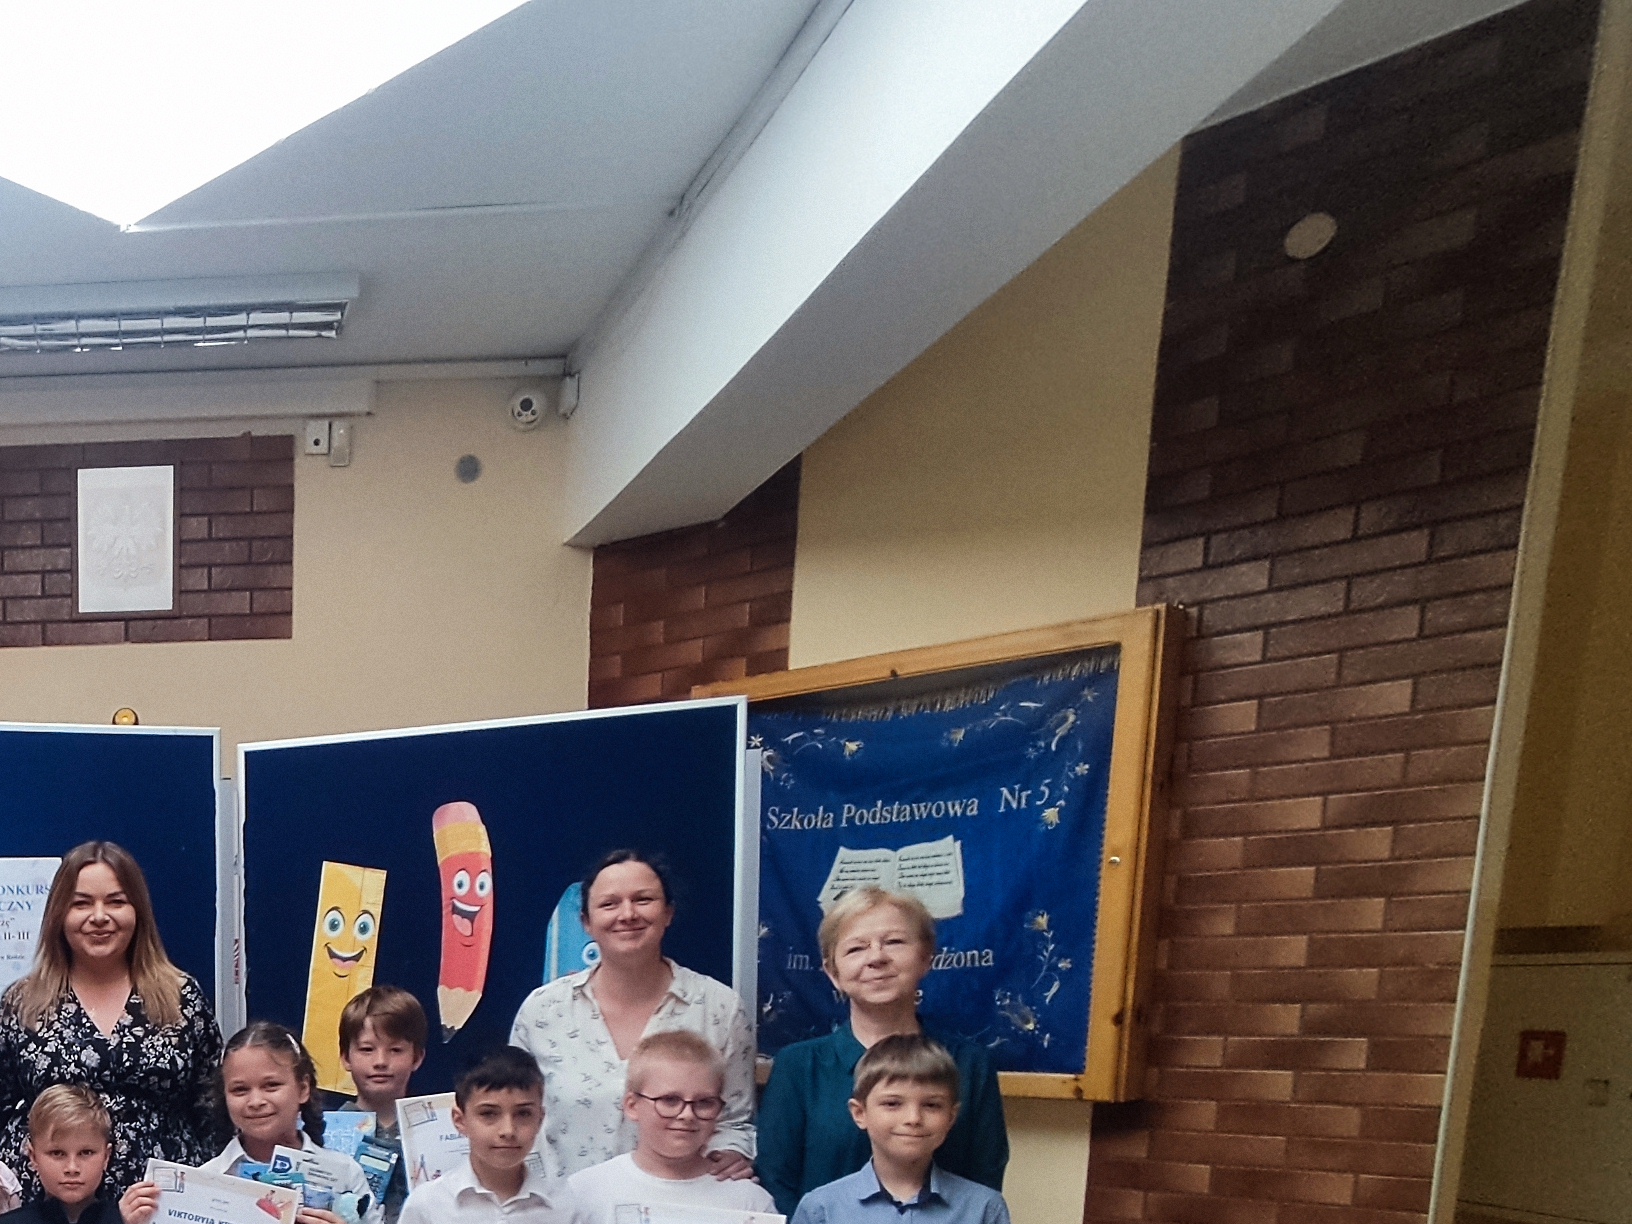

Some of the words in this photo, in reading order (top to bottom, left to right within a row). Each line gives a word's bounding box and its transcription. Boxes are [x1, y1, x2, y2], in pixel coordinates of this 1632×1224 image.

[767, 805, 834, 830] Szkoła
[840, 796, 979, 828] Podstawowa
[998, 784, 1032, 813] Nr
[1036, 779, 1052, 806] 5
[787, 946, 815, 970] im.
[931, 946, 994, 970] dżona
